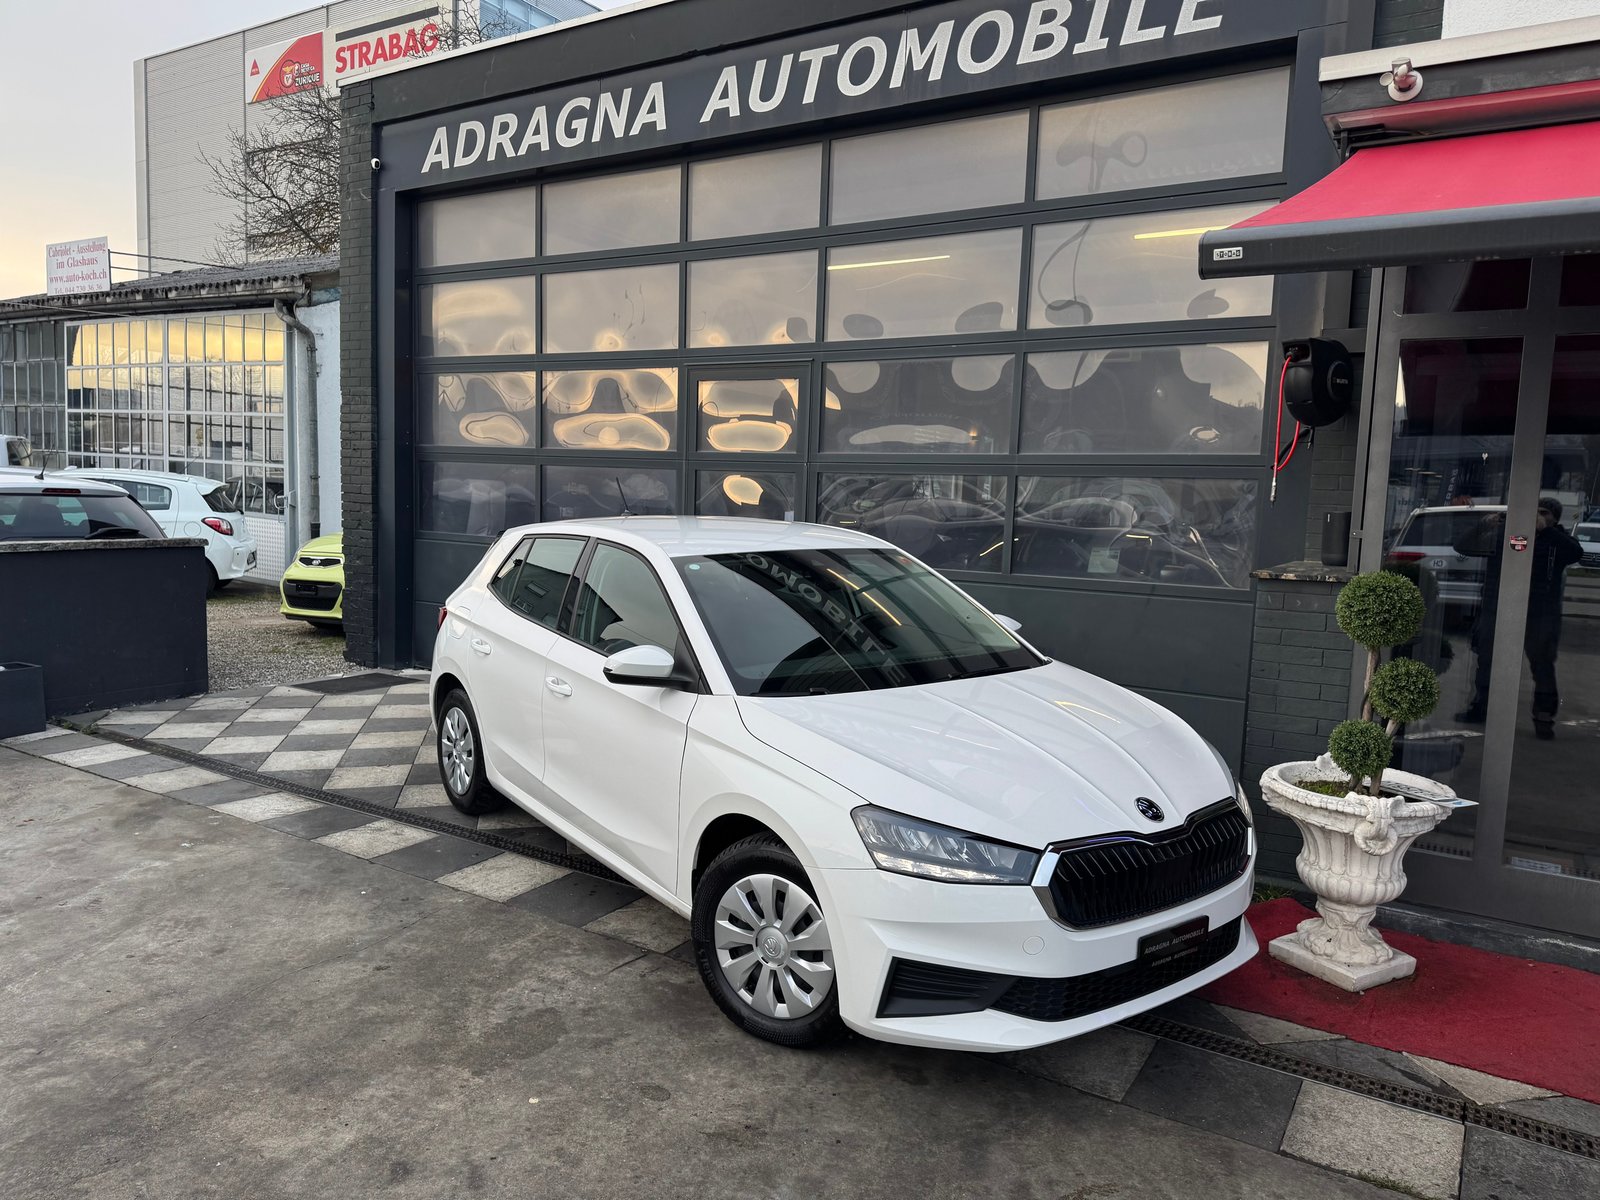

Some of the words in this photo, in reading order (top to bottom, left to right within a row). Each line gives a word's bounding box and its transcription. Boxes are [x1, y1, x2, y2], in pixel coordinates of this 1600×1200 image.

[335, 23, 439, 74] STRABAG
[421, 80, 668, 174] ADRAGNA
[56, 258, 65, 269] im
[67, 256, 98, 268] Glashaus
